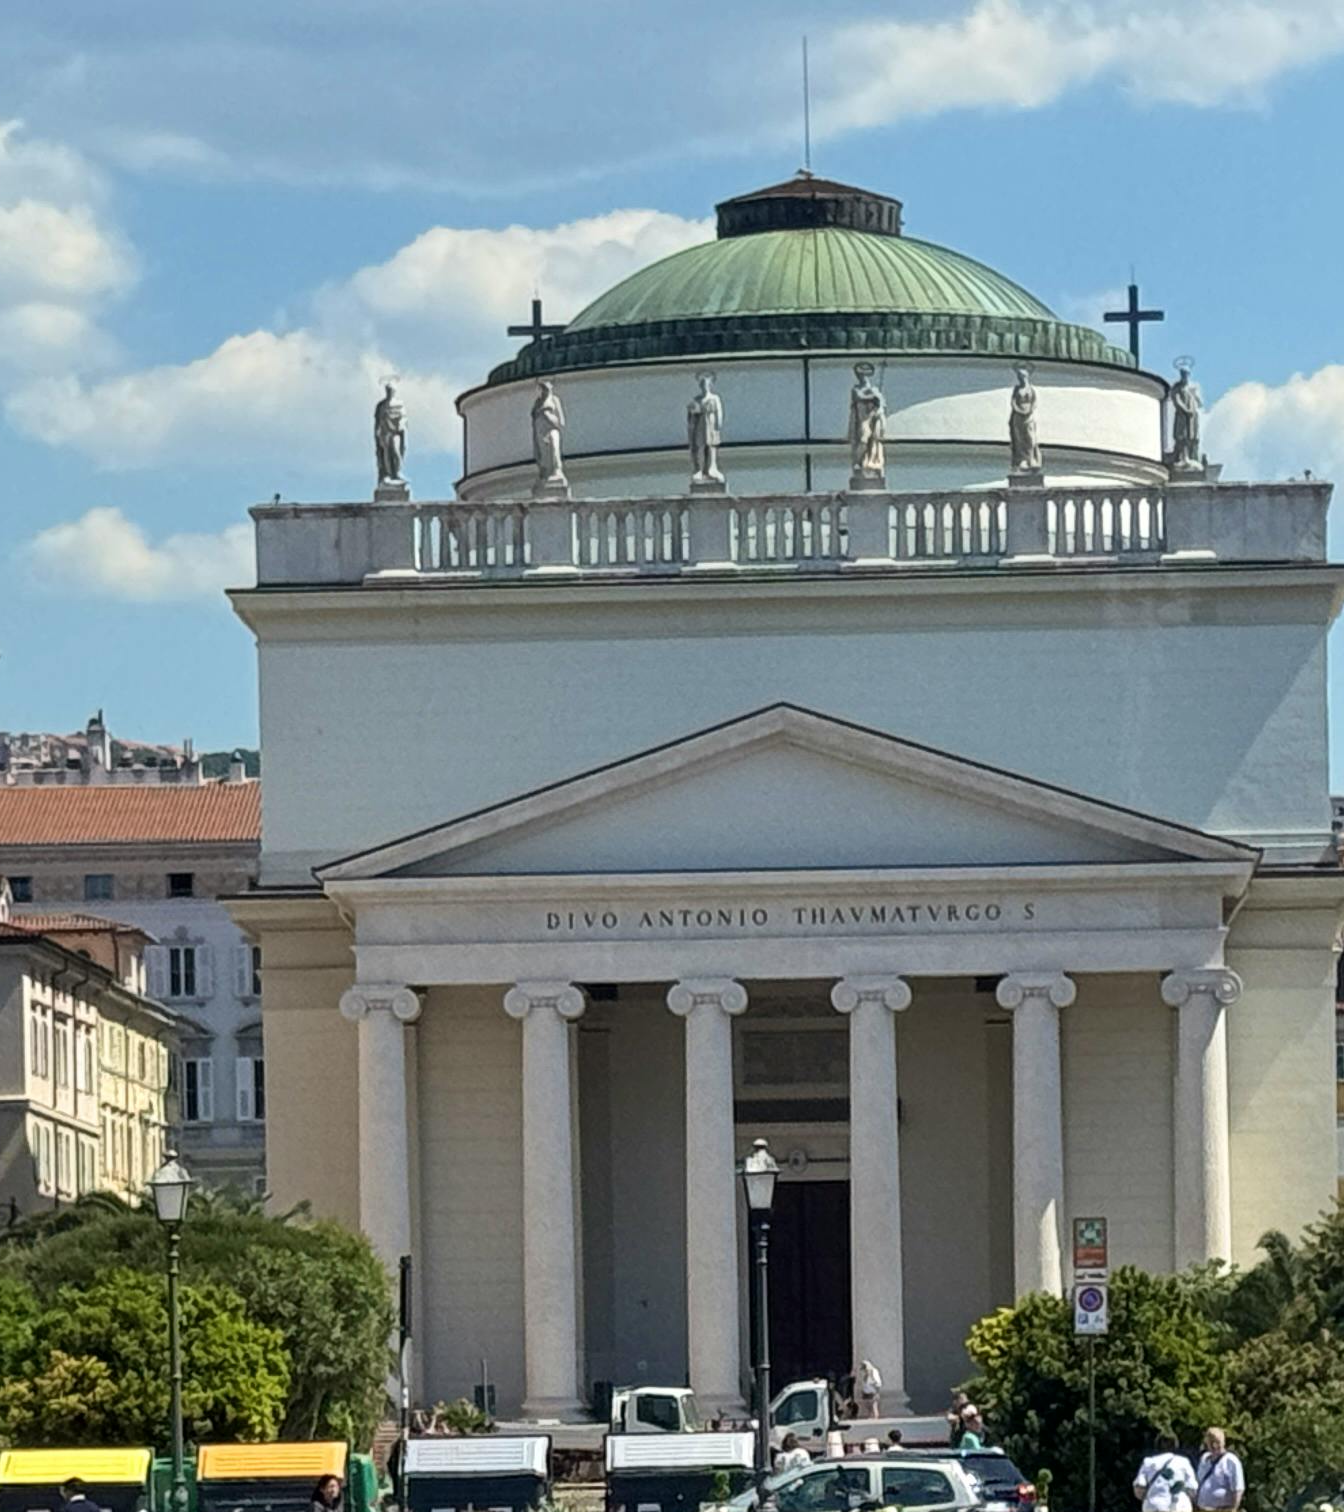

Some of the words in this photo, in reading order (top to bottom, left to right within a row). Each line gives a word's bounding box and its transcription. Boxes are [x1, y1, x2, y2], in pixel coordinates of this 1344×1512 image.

[546, 911, 618, 931] DIVO
[639, 908, 769, 928] ANTONIO
[792, 904, 1002, 925] THAVMATVRGO
[1023, 902, 1036, 921] S
